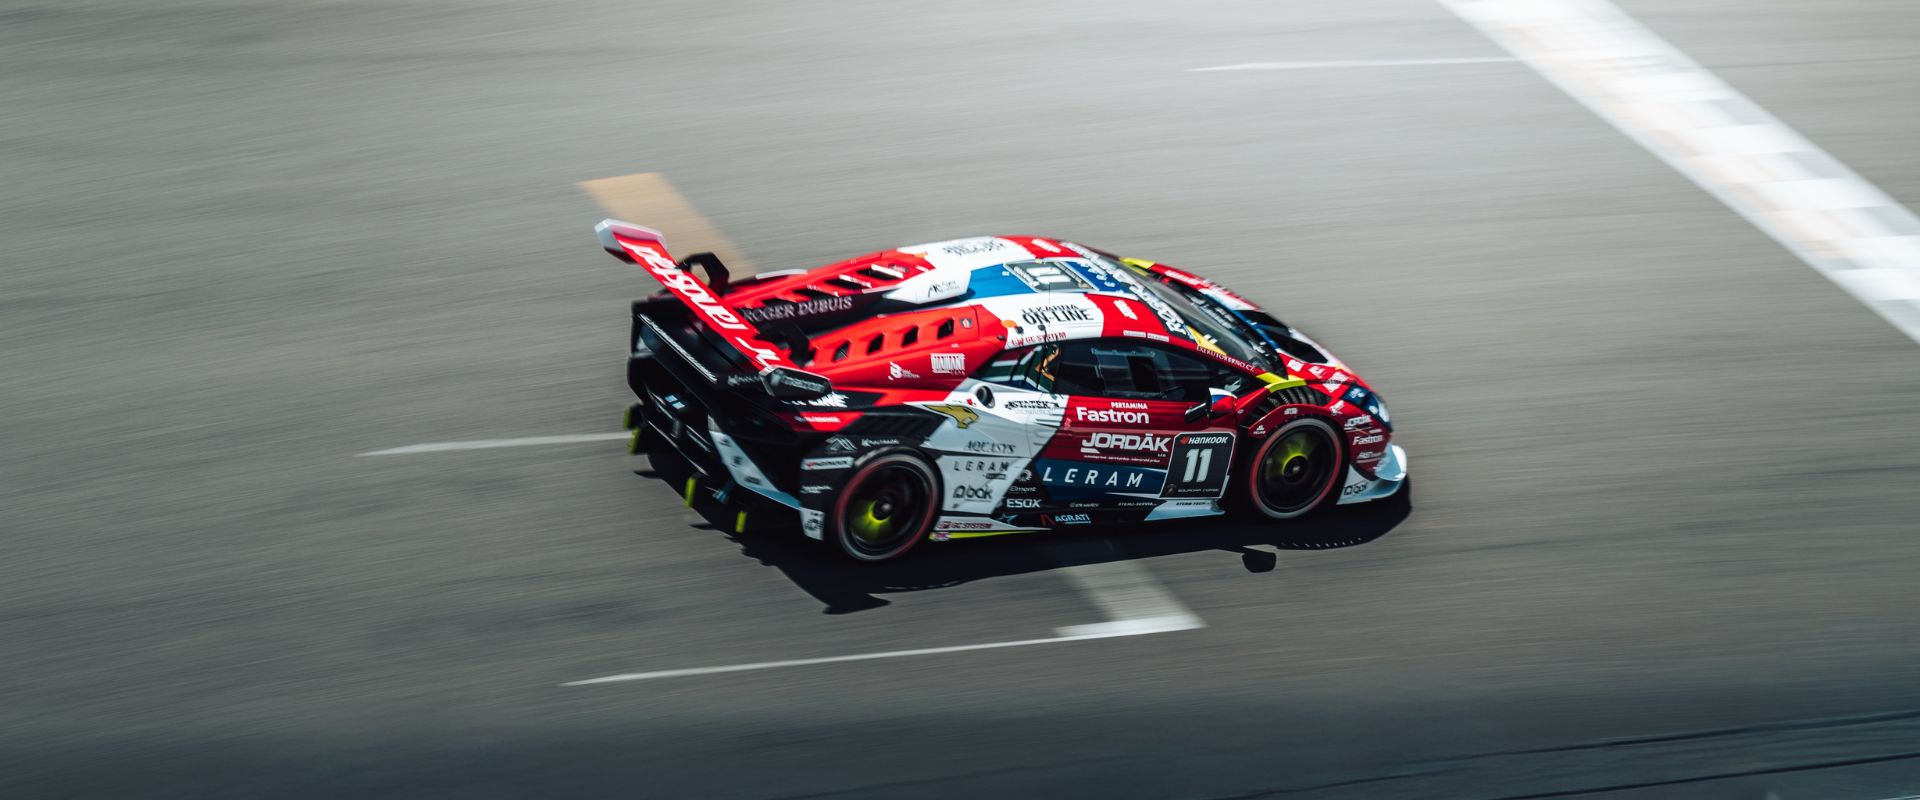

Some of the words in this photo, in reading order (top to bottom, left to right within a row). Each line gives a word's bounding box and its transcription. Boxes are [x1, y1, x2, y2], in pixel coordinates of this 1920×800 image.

[797, 296, 853, 316] DUBUIS
[1022, 309, 1094, 325] ON-LINE
[1110, 402, 1148, 410] PERTAMINA
[1076, 406, 1149, 424] Fastron
[953, 461, 1009, 472] LERAM
[1182, 448, 1213, 483] 11
[1042, 467, 1143, 488] LERAM
[1006, 498, 1042, 508] ESOX
[1054, 514, 1091, 522] AGRATI
